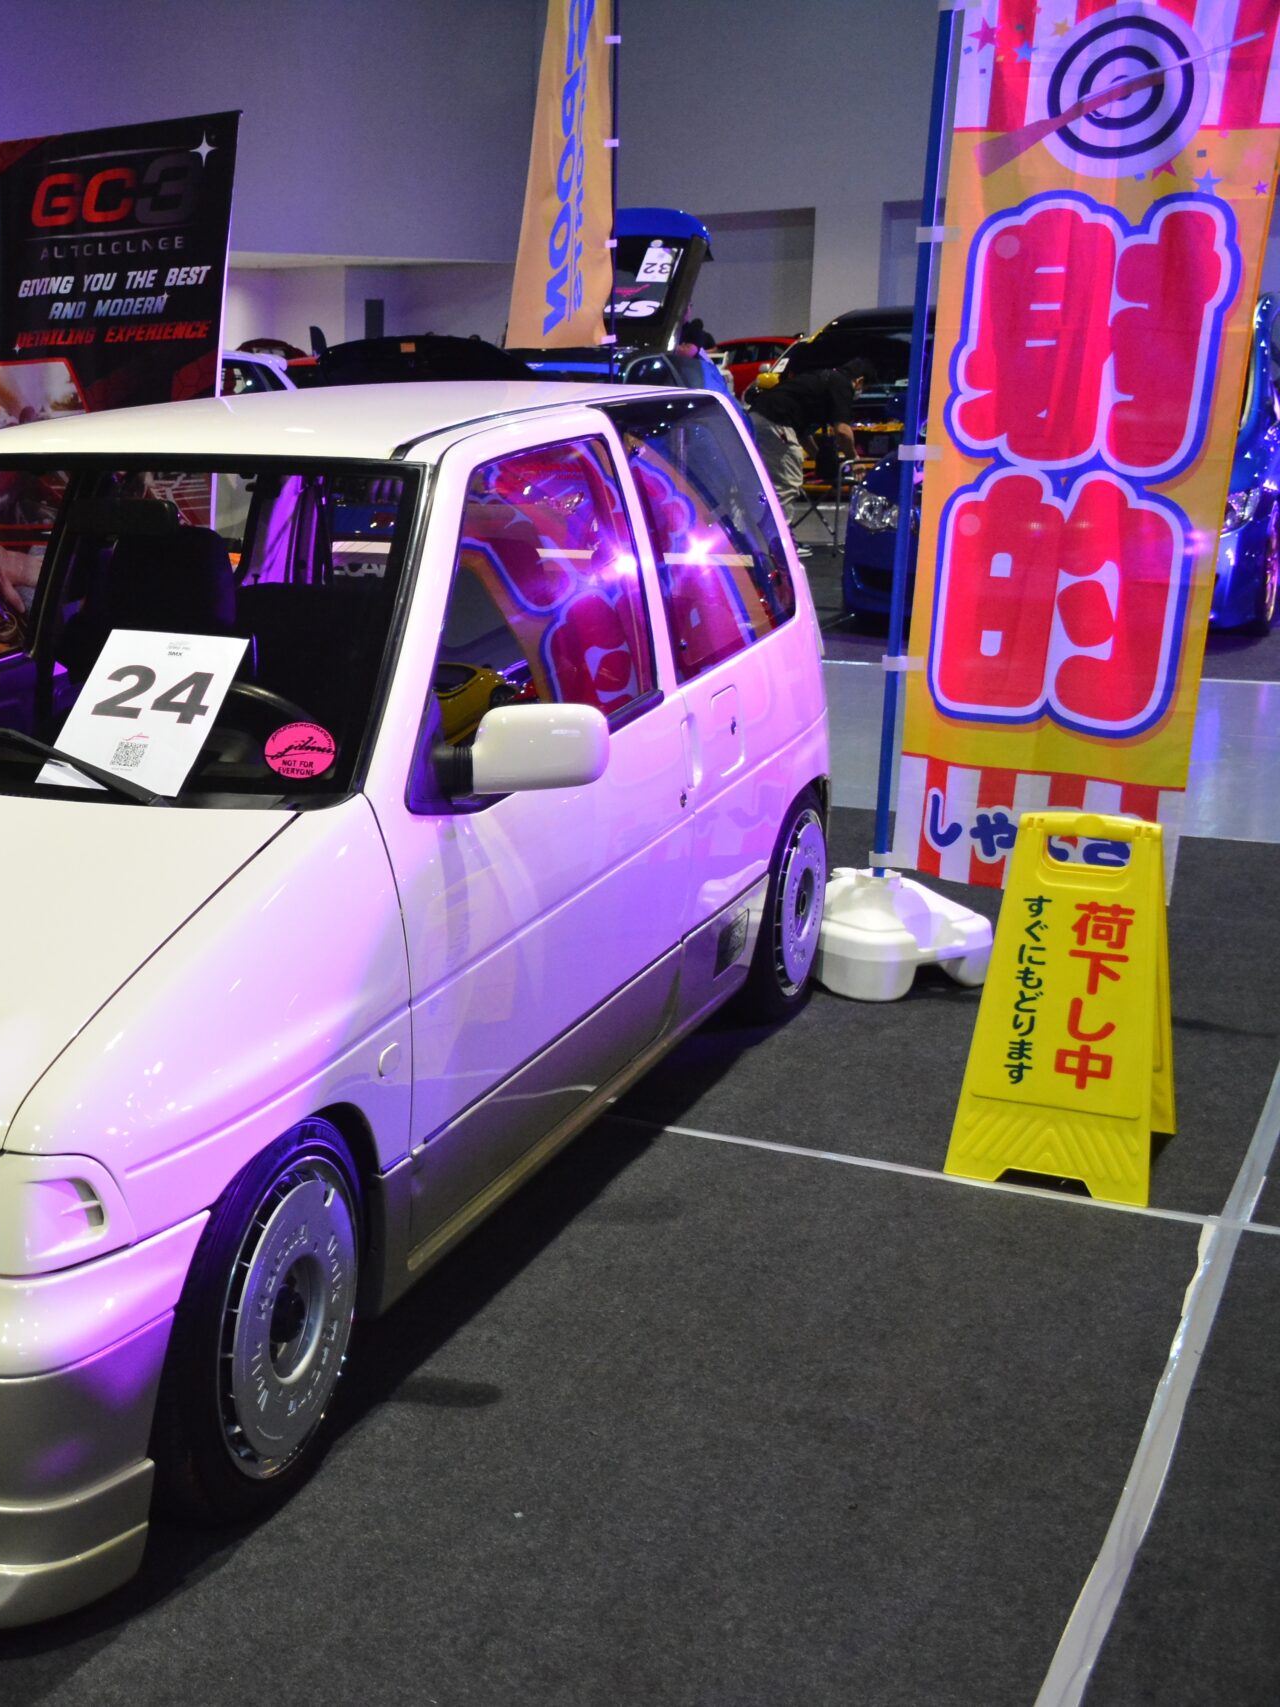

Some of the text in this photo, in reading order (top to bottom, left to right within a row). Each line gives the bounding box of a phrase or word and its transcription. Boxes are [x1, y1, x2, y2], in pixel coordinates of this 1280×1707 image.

[31, 152, 195, 228] GC3
[40, 236, 185, 260] AUTOLOUNGE
[18, 265, 211, 298] GIVING YOU THE BEST
[643, 262, 671, 274] 32
[48, 296, 168, 320] AND MODERN
[104, 320, 212, 343] EXPERIENCE
[933, 194, 1235, 732] 射的
[91, 664, 215, 725] 24
[278, 766, 315, 776] EVERYONE
[281, 759, 314, 768] NOT FOR
[1004, 895, 1052, 1085] すぐにもどります
[1054, 901, 1136, 1090] 荷下し中
